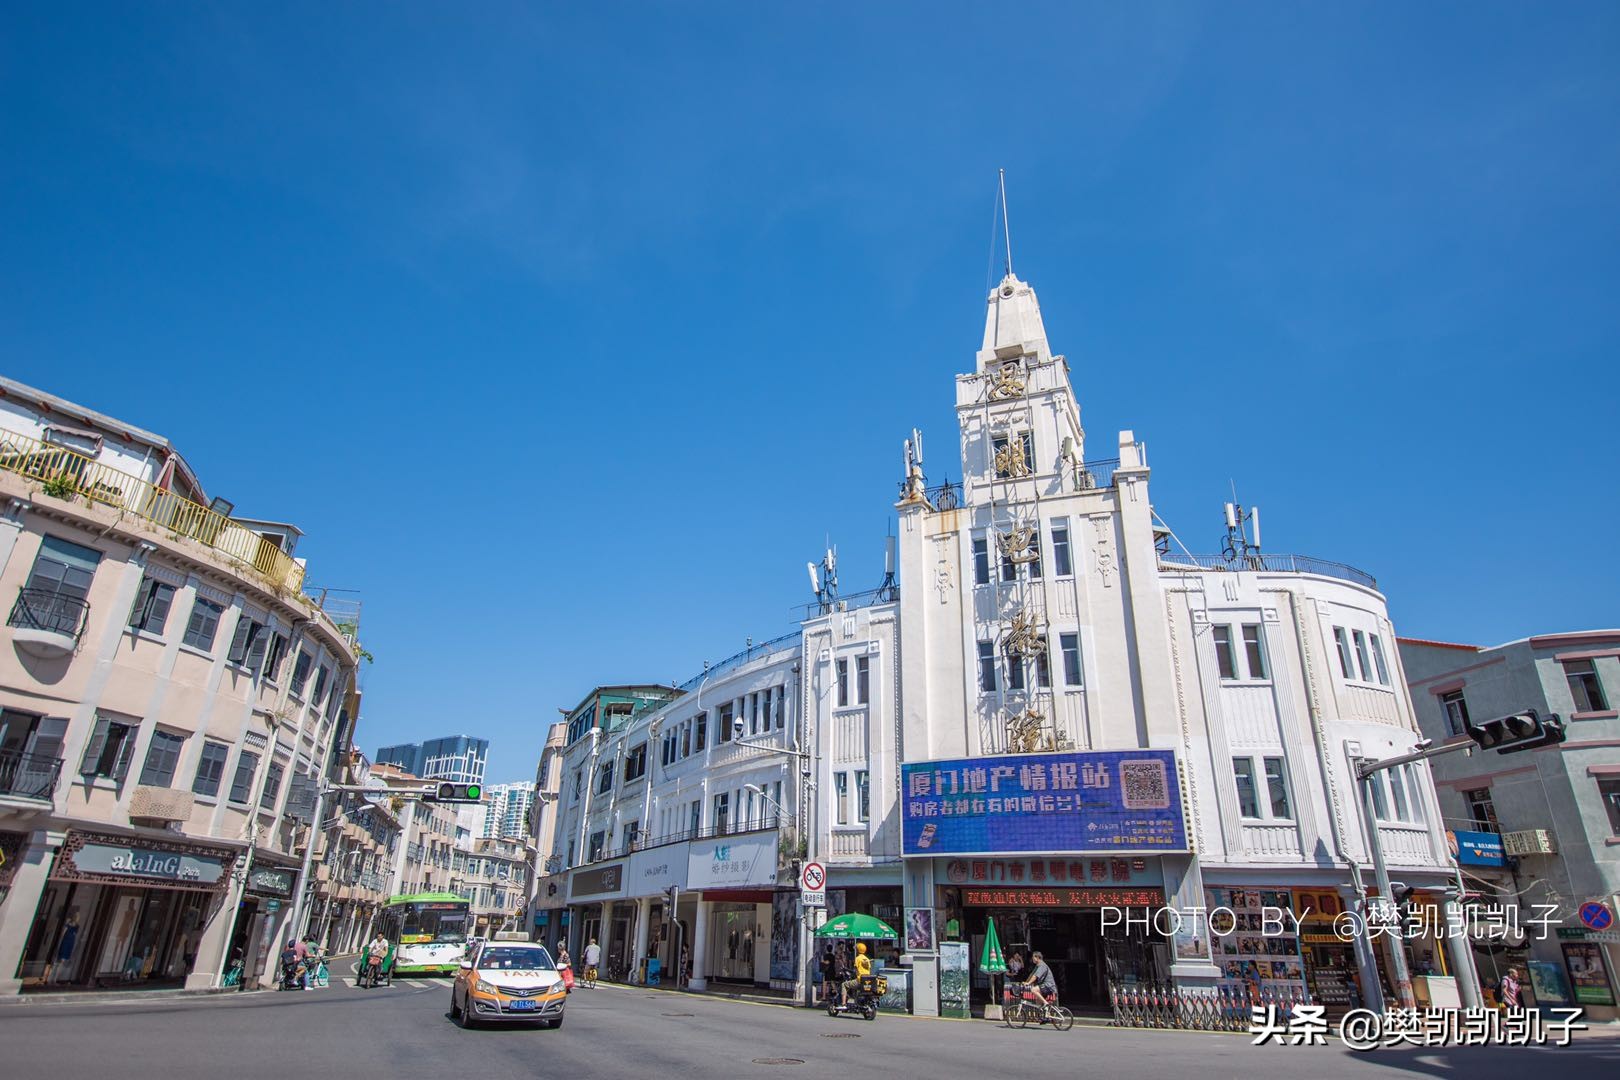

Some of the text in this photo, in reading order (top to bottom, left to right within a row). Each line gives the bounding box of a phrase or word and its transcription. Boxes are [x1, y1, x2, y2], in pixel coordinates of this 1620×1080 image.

[908, 762, 1111, 797] 厦门地产情报站
[712, 860, 750, 874] 婚纱摄影
[972, 858, 1131, 883] 厦门市思明电影院
[503, 970, 540, 978] TAXI
